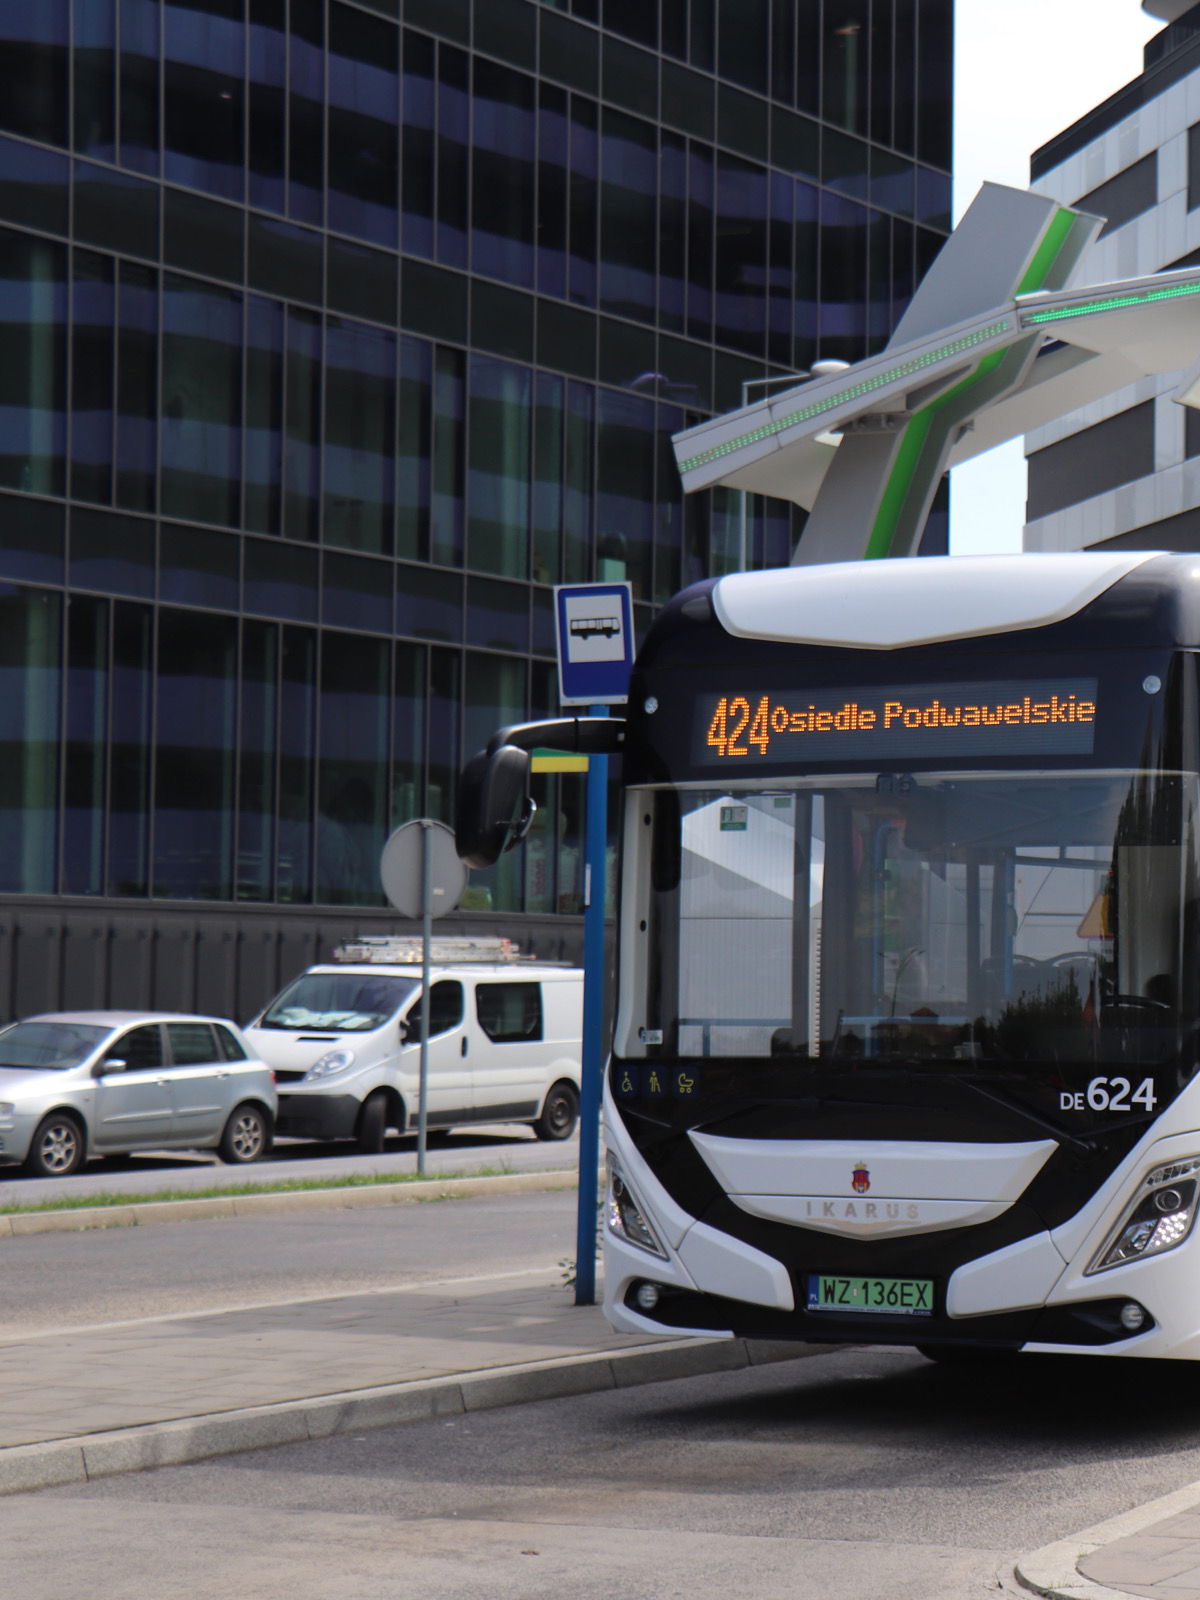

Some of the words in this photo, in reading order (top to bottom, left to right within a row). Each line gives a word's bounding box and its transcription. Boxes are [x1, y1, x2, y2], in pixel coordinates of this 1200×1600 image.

[707, 696, 770, 756] 424
[770, 703, 877, 733] Osiedle
[883, 695, 1096, 729] Podwawelskie
[806, 1200, 920, 1219] IKARUS
[823, 1279, 851, 1305] WZ
[861, 1281, 929, 1308] 136EX
